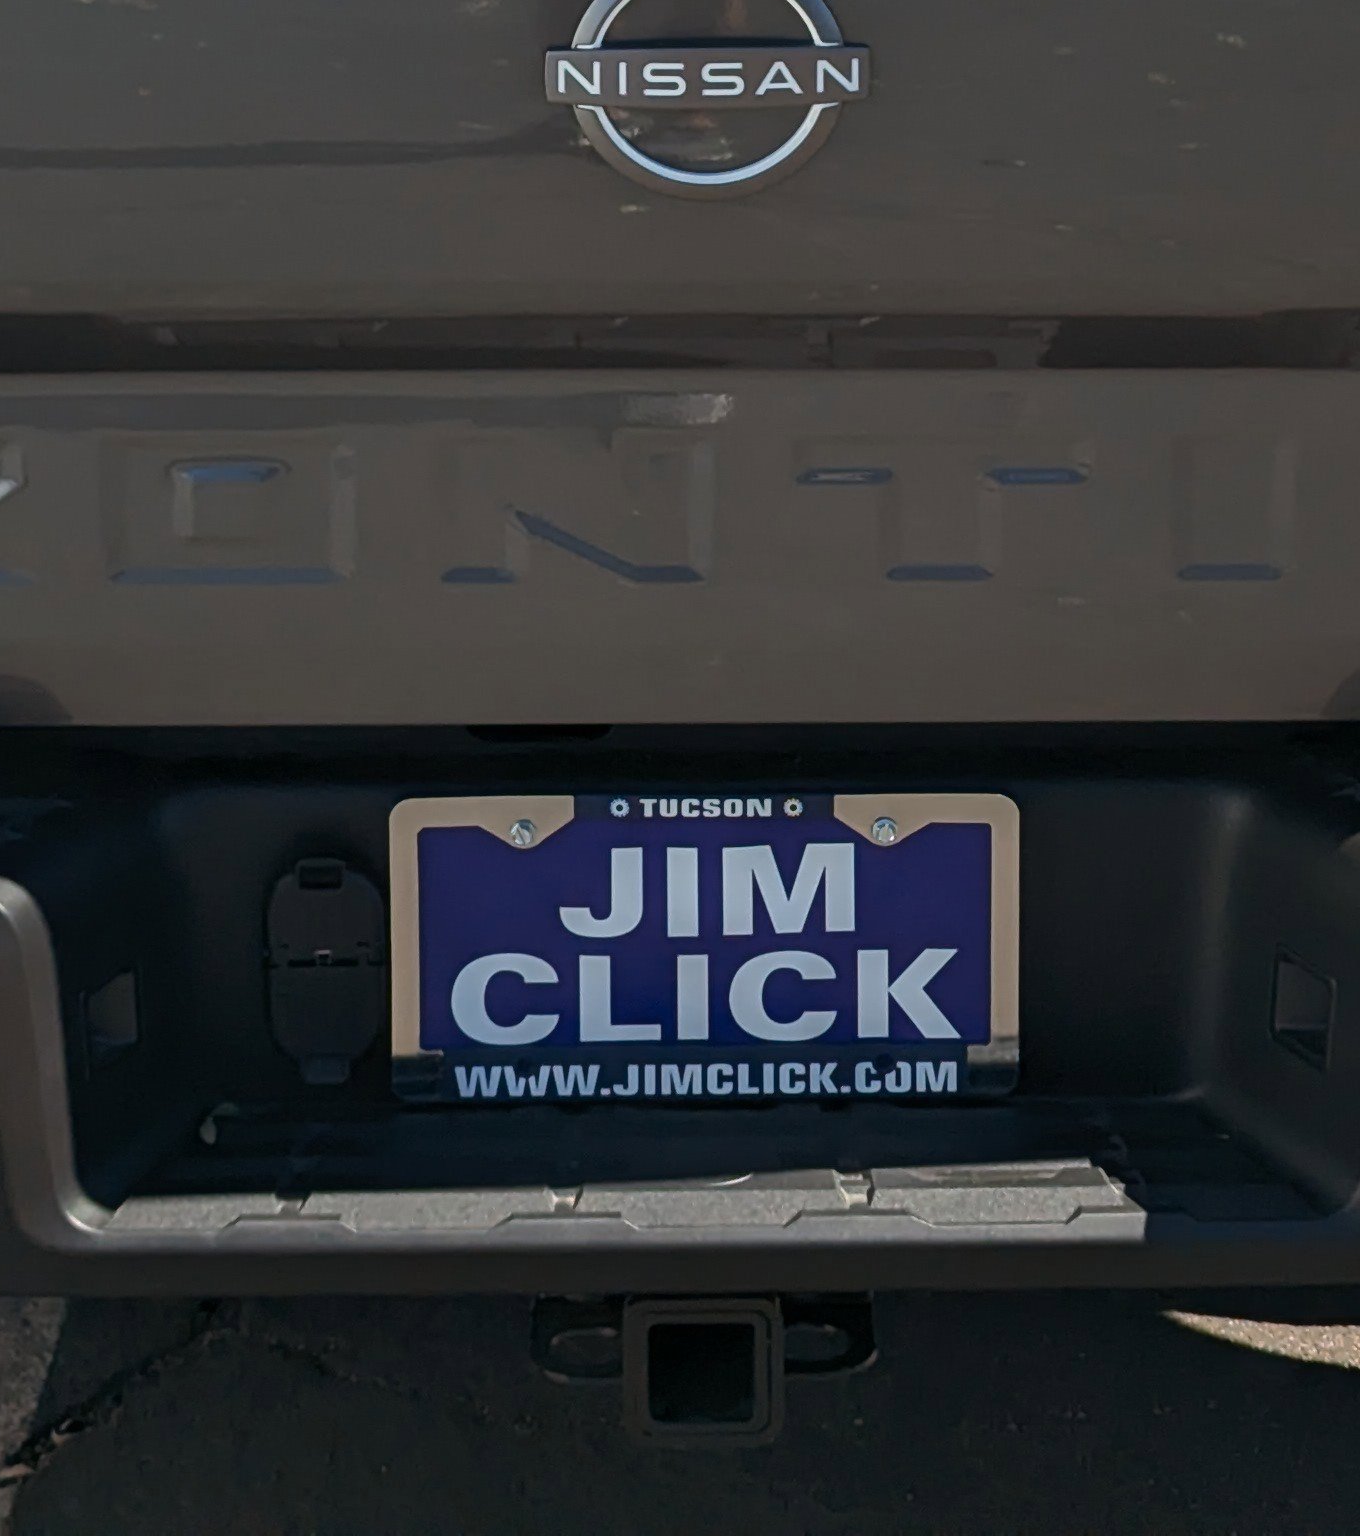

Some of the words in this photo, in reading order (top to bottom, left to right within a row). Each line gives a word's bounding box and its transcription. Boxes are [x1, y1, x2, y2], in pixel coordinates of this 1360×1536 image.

[556, 57, 860, 97] NISSAN
[639, 797, 774, 819] TUCSON
[558, 841, 857, 939] JIM
[449, 947, 963, 1046] CLICK
[453, 1060, 960, 1099] WWW.JIMCLICK.COM
